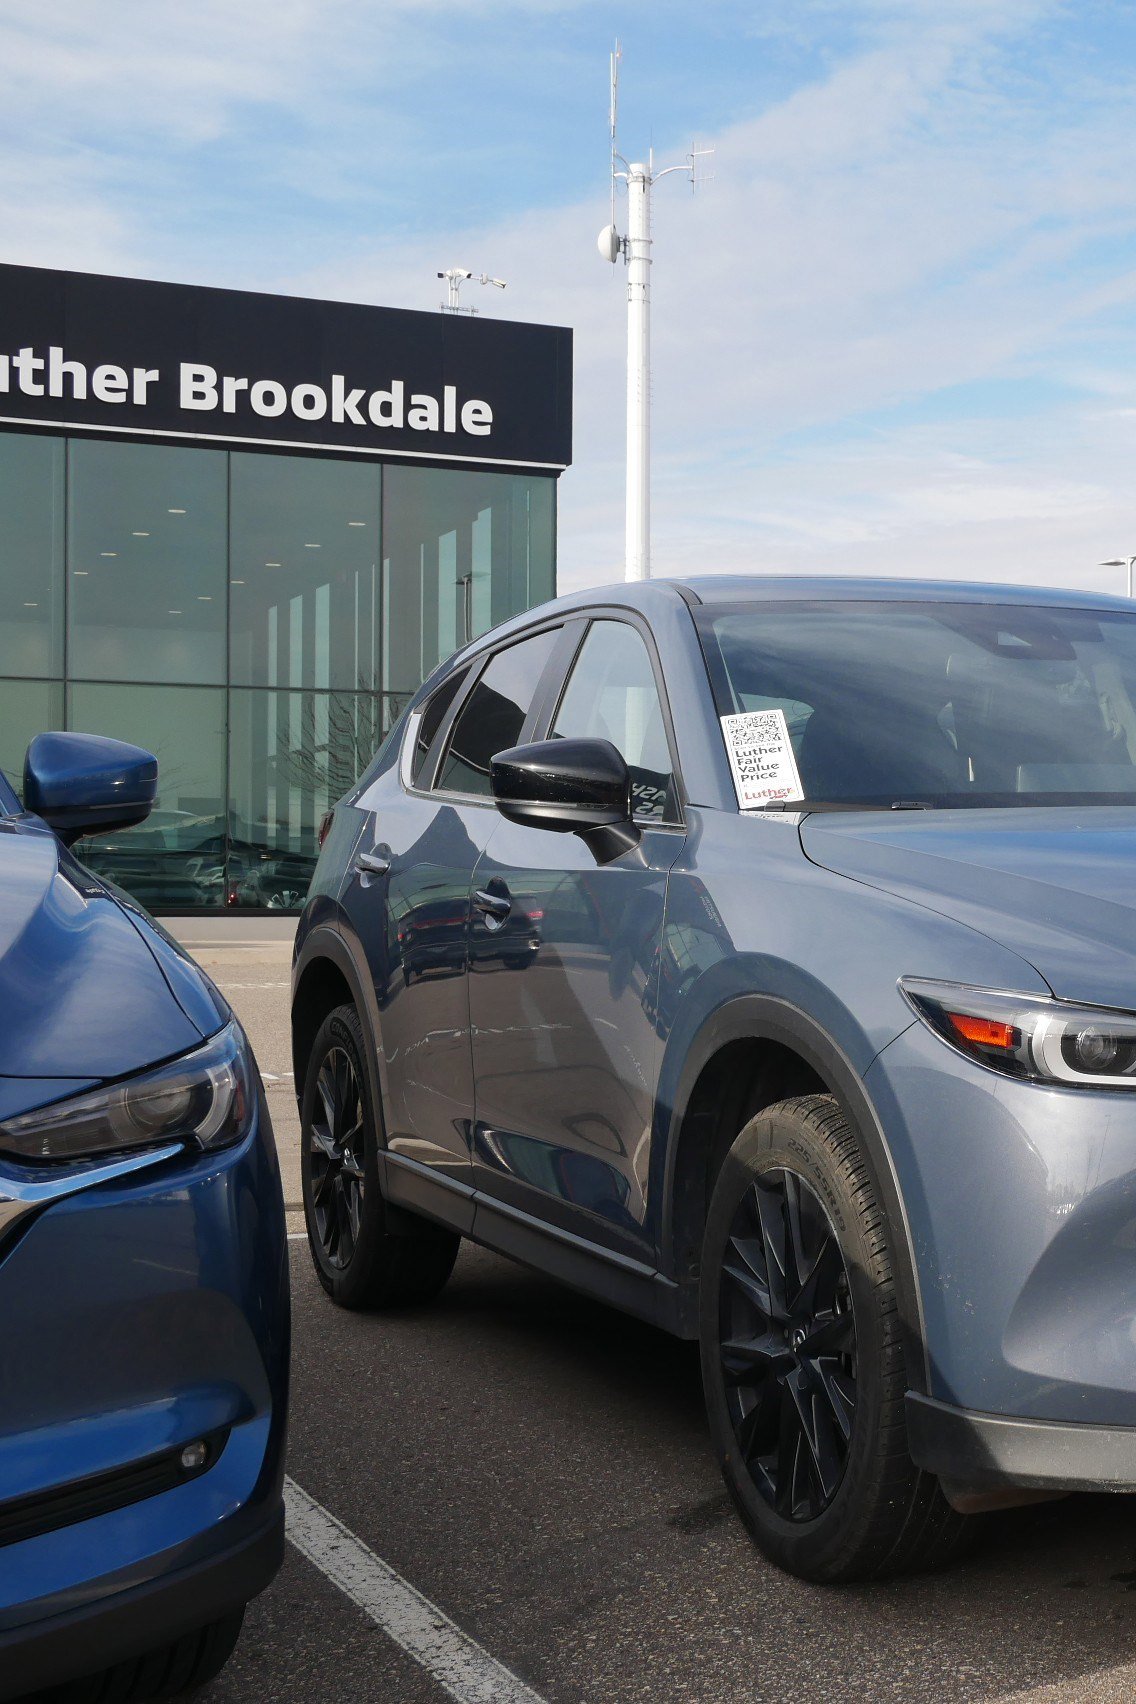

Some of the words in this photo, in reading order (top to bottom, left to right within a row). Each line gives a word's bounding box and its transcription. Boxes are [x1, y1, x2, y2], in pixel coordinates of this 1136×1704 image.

[179, 362, 494, 436] Brookdale
[735, 746, 783, 758] Luther
[737, 756, 763, 766] Fair
[738, 763, 780, 773] Value
[740, 771, 778, 782] Price
[744, 787, 794, 800] Luther
